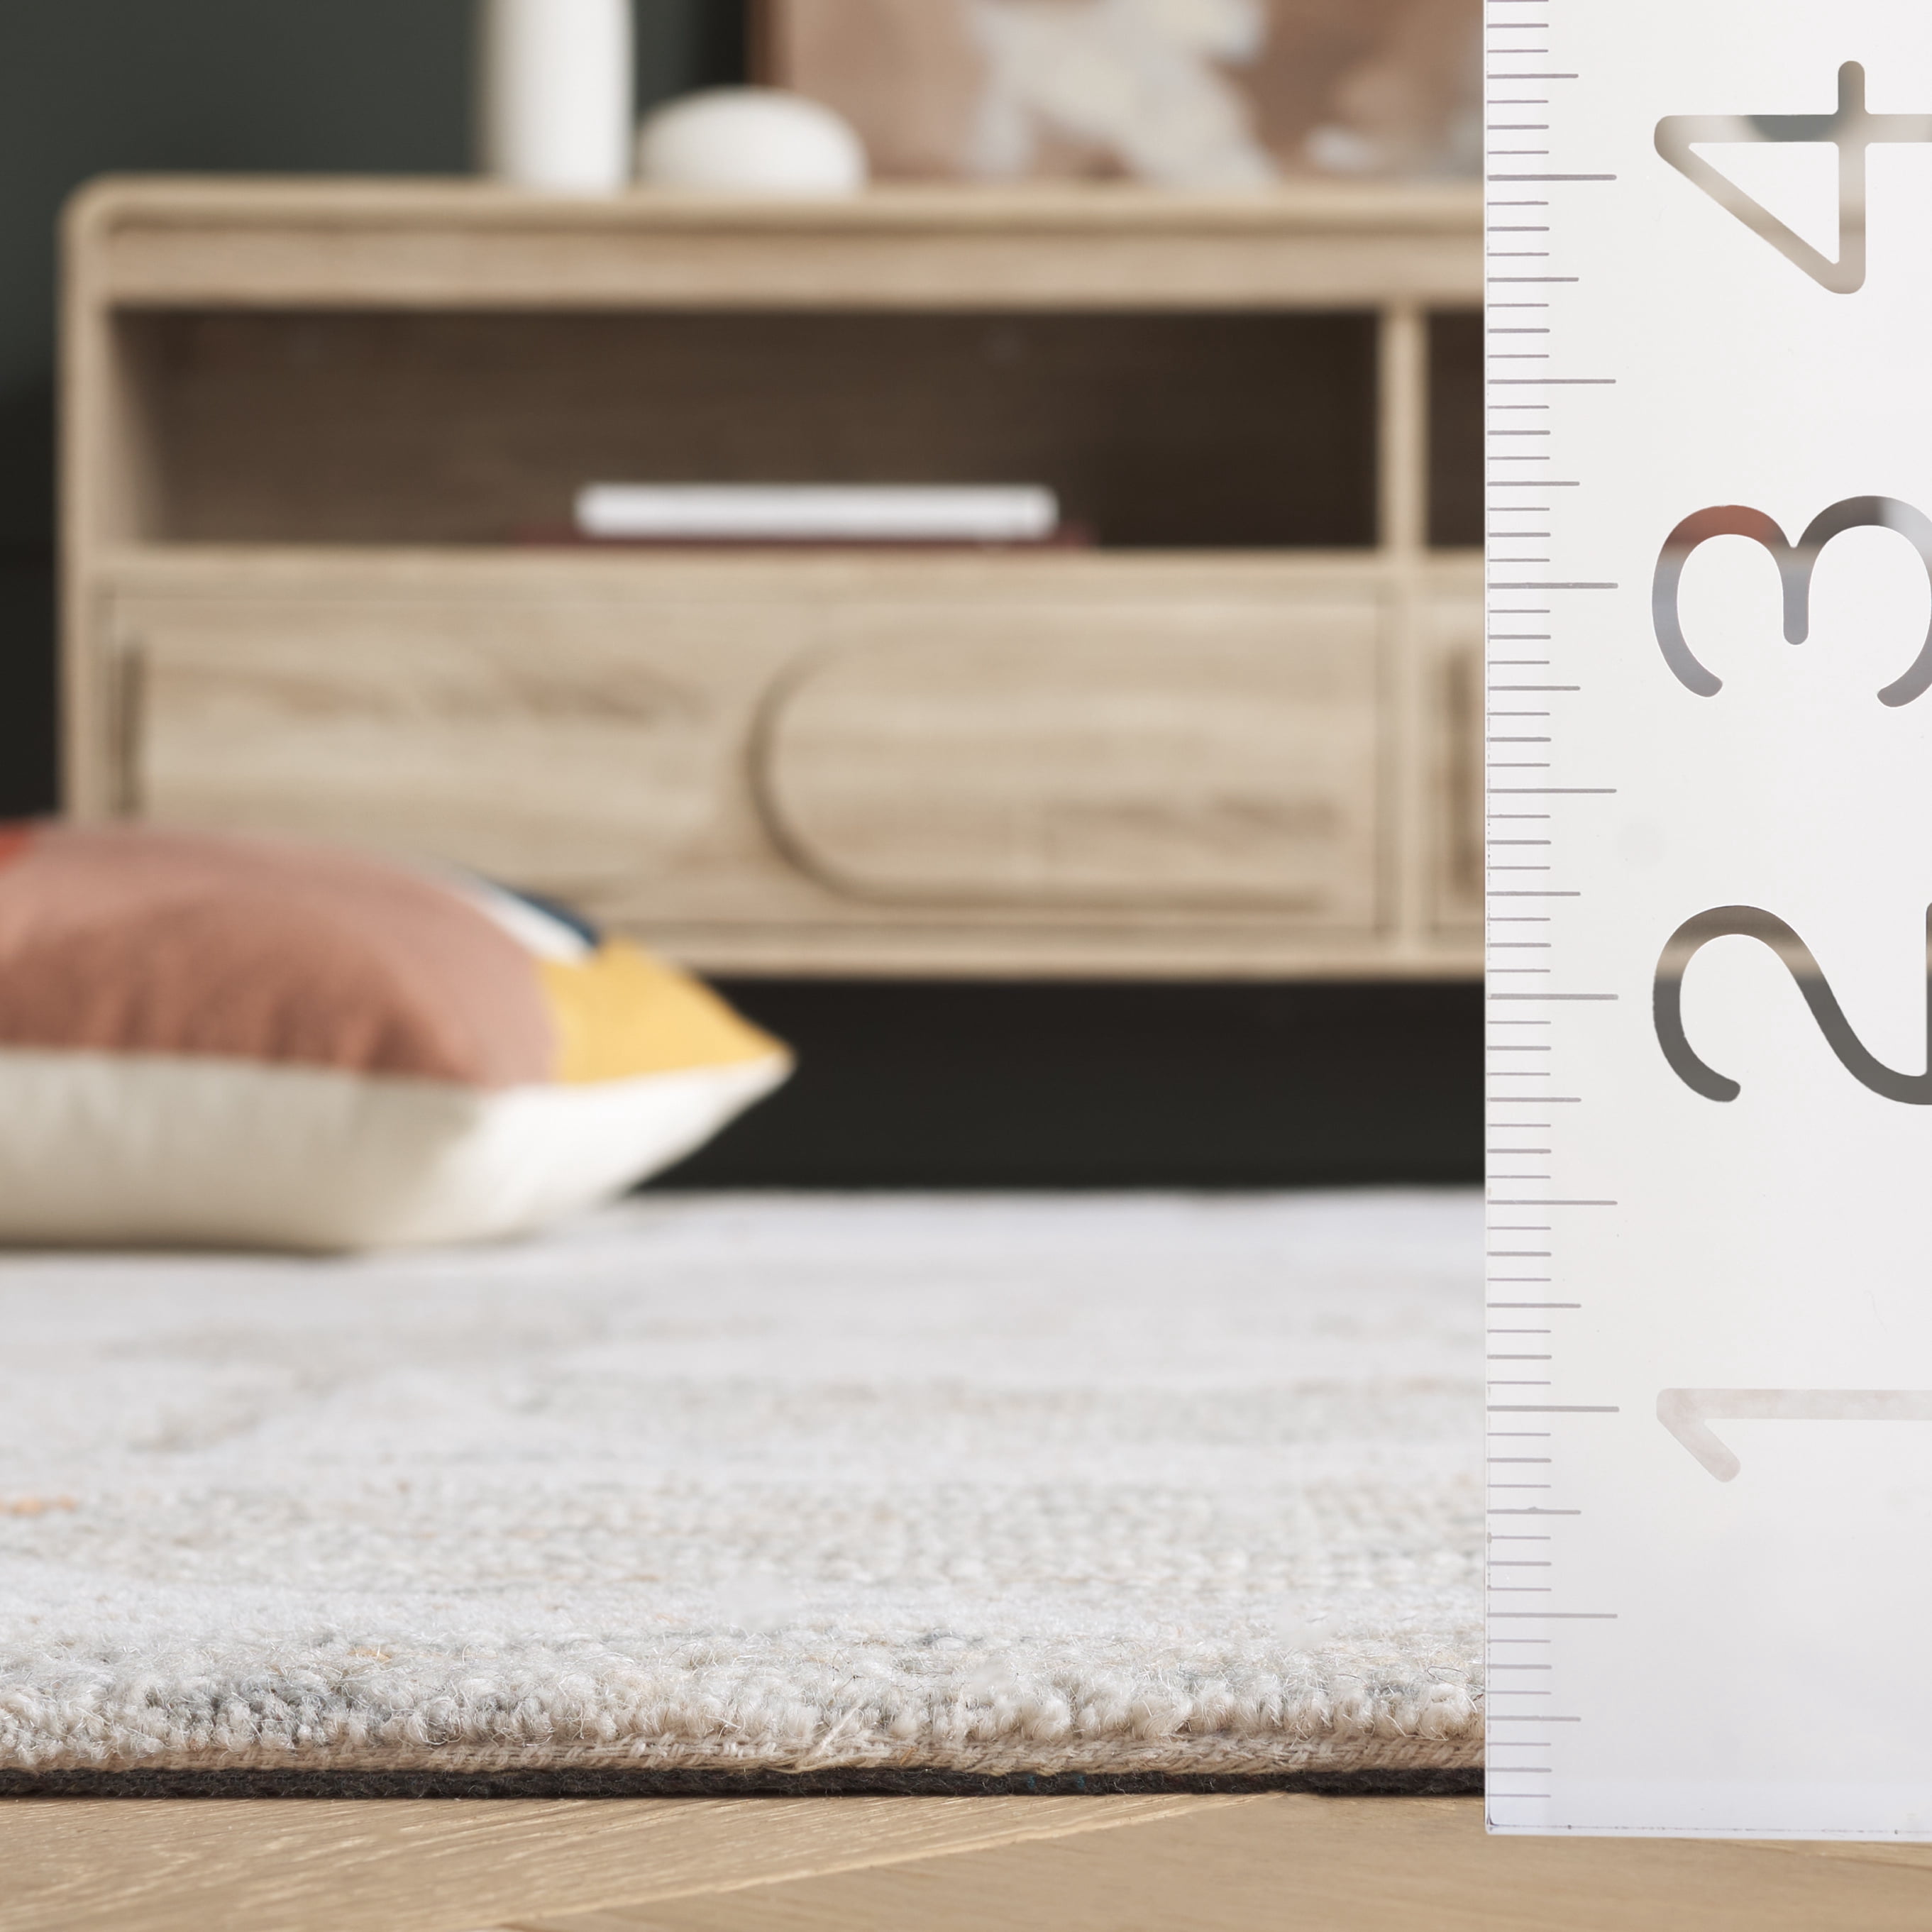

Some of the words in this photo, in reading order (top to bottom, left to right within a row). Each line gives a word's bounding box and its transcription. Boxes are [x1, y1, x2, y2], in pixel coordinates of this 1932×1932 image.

[1654, 60, 1932, 294] 4
[1651, 495, 1932, 708] 3
[1652, 905, 1932, 1105] 2
[1656, 1388, 1932, 1482] 1
